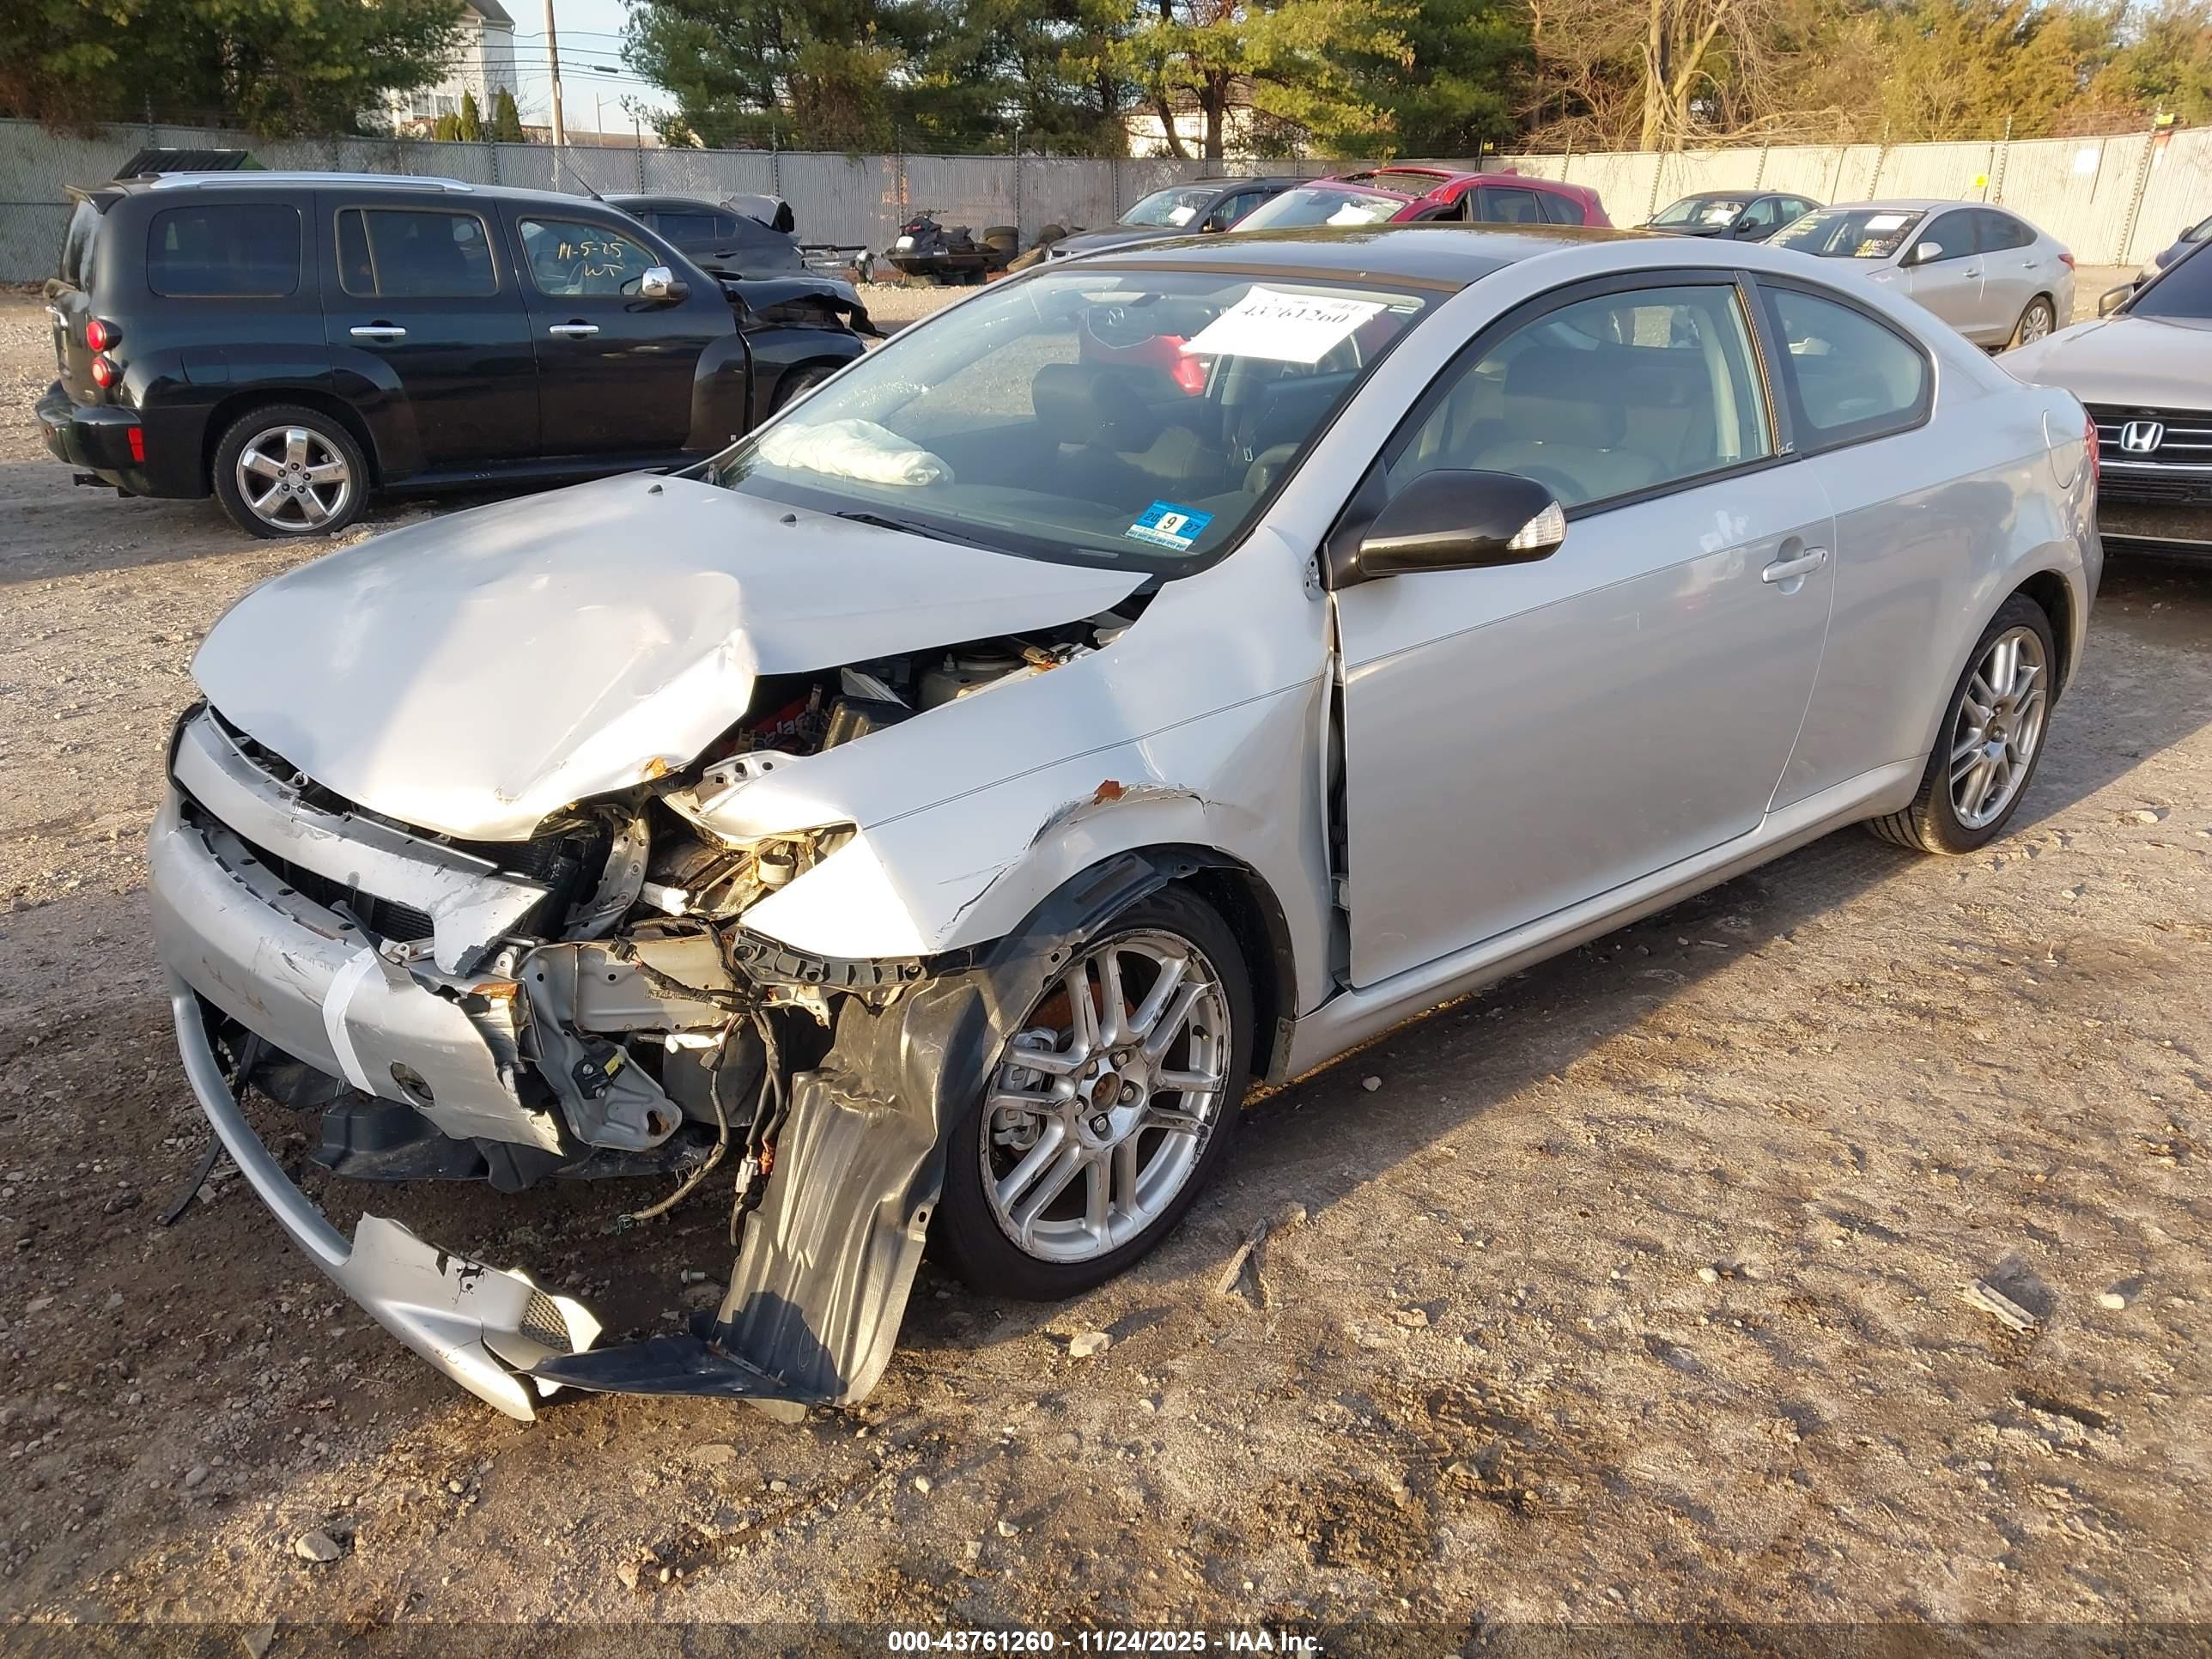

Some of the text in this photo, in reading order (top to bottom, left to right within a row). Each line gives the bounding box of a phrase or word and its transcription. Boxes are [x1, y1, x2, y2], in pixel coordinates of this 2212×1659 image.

[1144, 512, 1201, 533] 20 9 27
